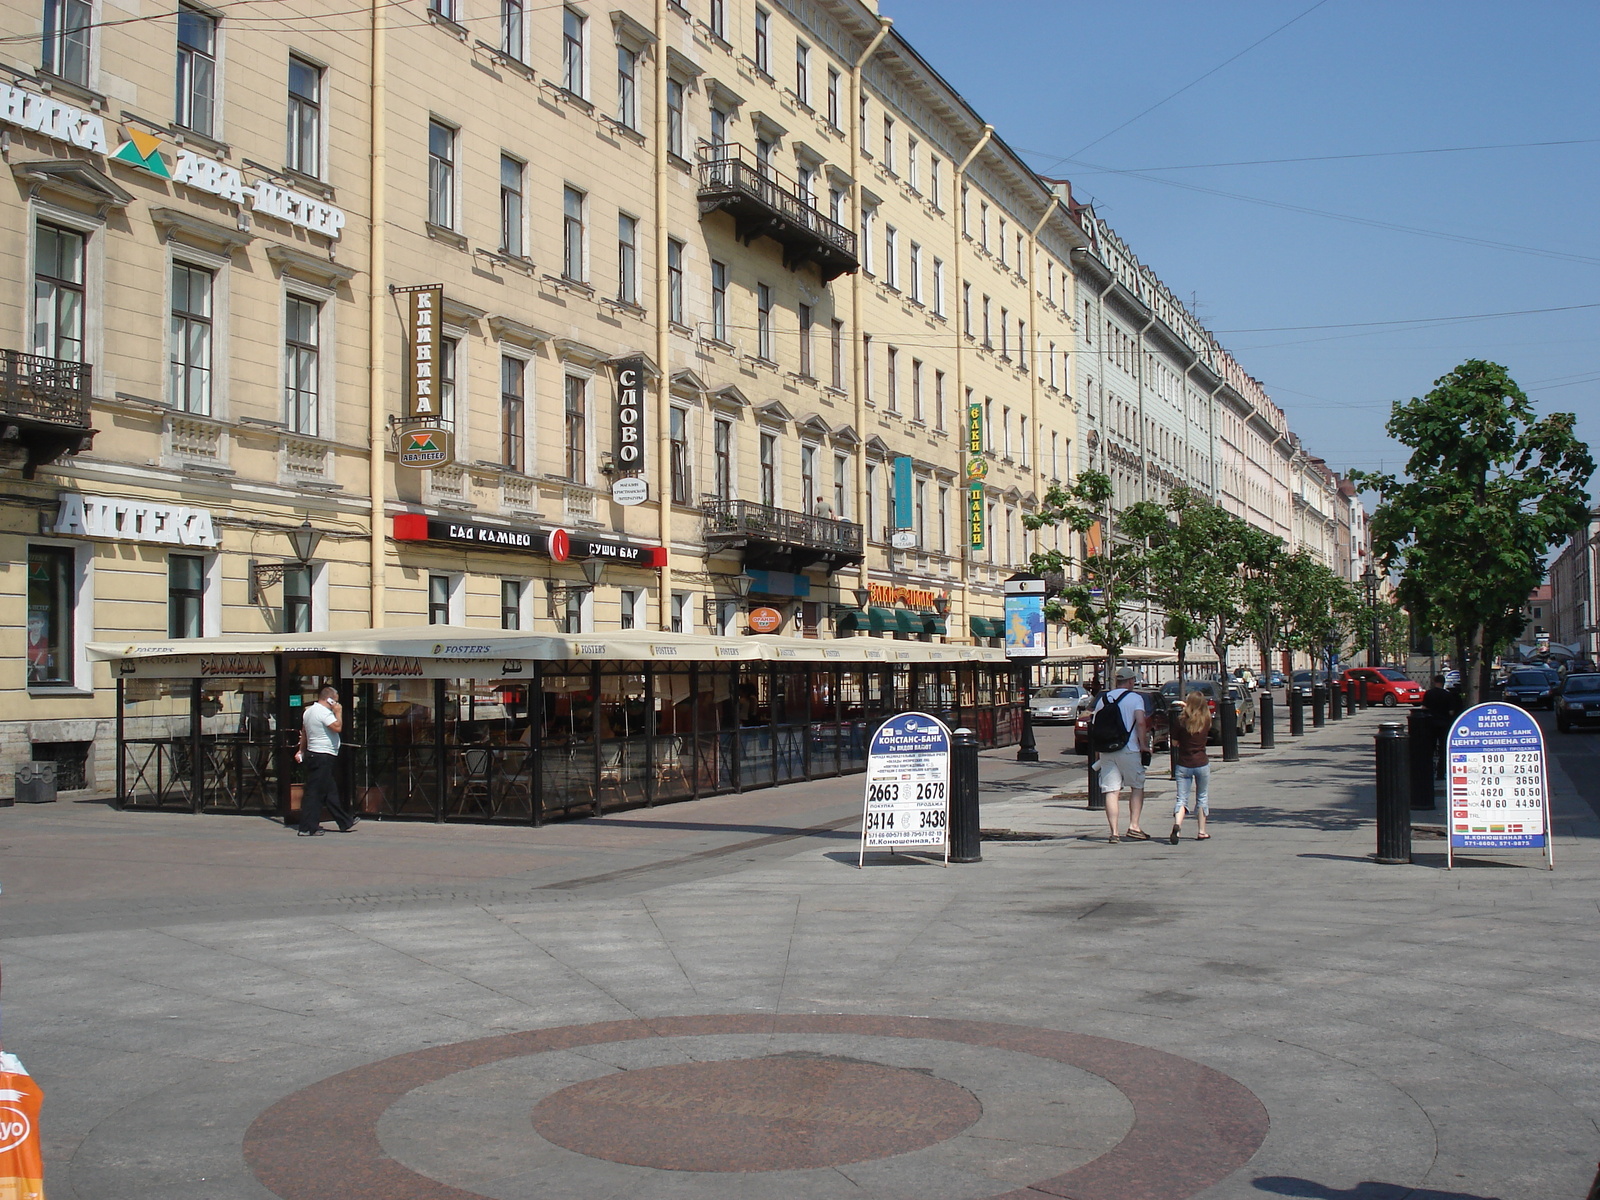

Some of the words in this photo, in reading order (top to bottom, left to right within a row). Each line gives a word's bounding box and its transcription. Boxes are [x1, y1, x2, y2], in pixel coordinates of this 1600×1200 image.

[172, 149, 346, 238] АВА-ПЕТЕР
[416, 292, 432, 413] КЛИНИКА
[619, 369, 639, 462] СЛОВО
[971, 407, 980, 451] ЁЛКИ
[53, 493, 217, 547] АПТЕКА
[972, 490, 982, 544] ПАЛКИ
[450, 525, 474, 540] САД
[478, 529, 531, 546] КАМНЕЙ
[589, 543, 617, 557] СУШИ
[619, 548, 639, 559] БАР
[444, 645, 492, 653] FOSTER'S
[581, 644, 606, 654] FOSTER'S
[655, 646, 678, 655] FOSTER'S
[879, 735, 942, 744] КОНСТАНС-БАНК
[1451, 739, 1480, 747] ЦЕНТР
[1481, 754, 1505, 763] 1900
[1515, 753, 1539, 762] 2220
[1516, 775, 1540, 785] 3650
[869, 784, 899, 802] 2663
[916, 782, 945, 800] 2678
[1480, 788, 1504, 797] 4620
[867, 812, 895, 830] 3414
[919, 810, 946, 828] 3438
